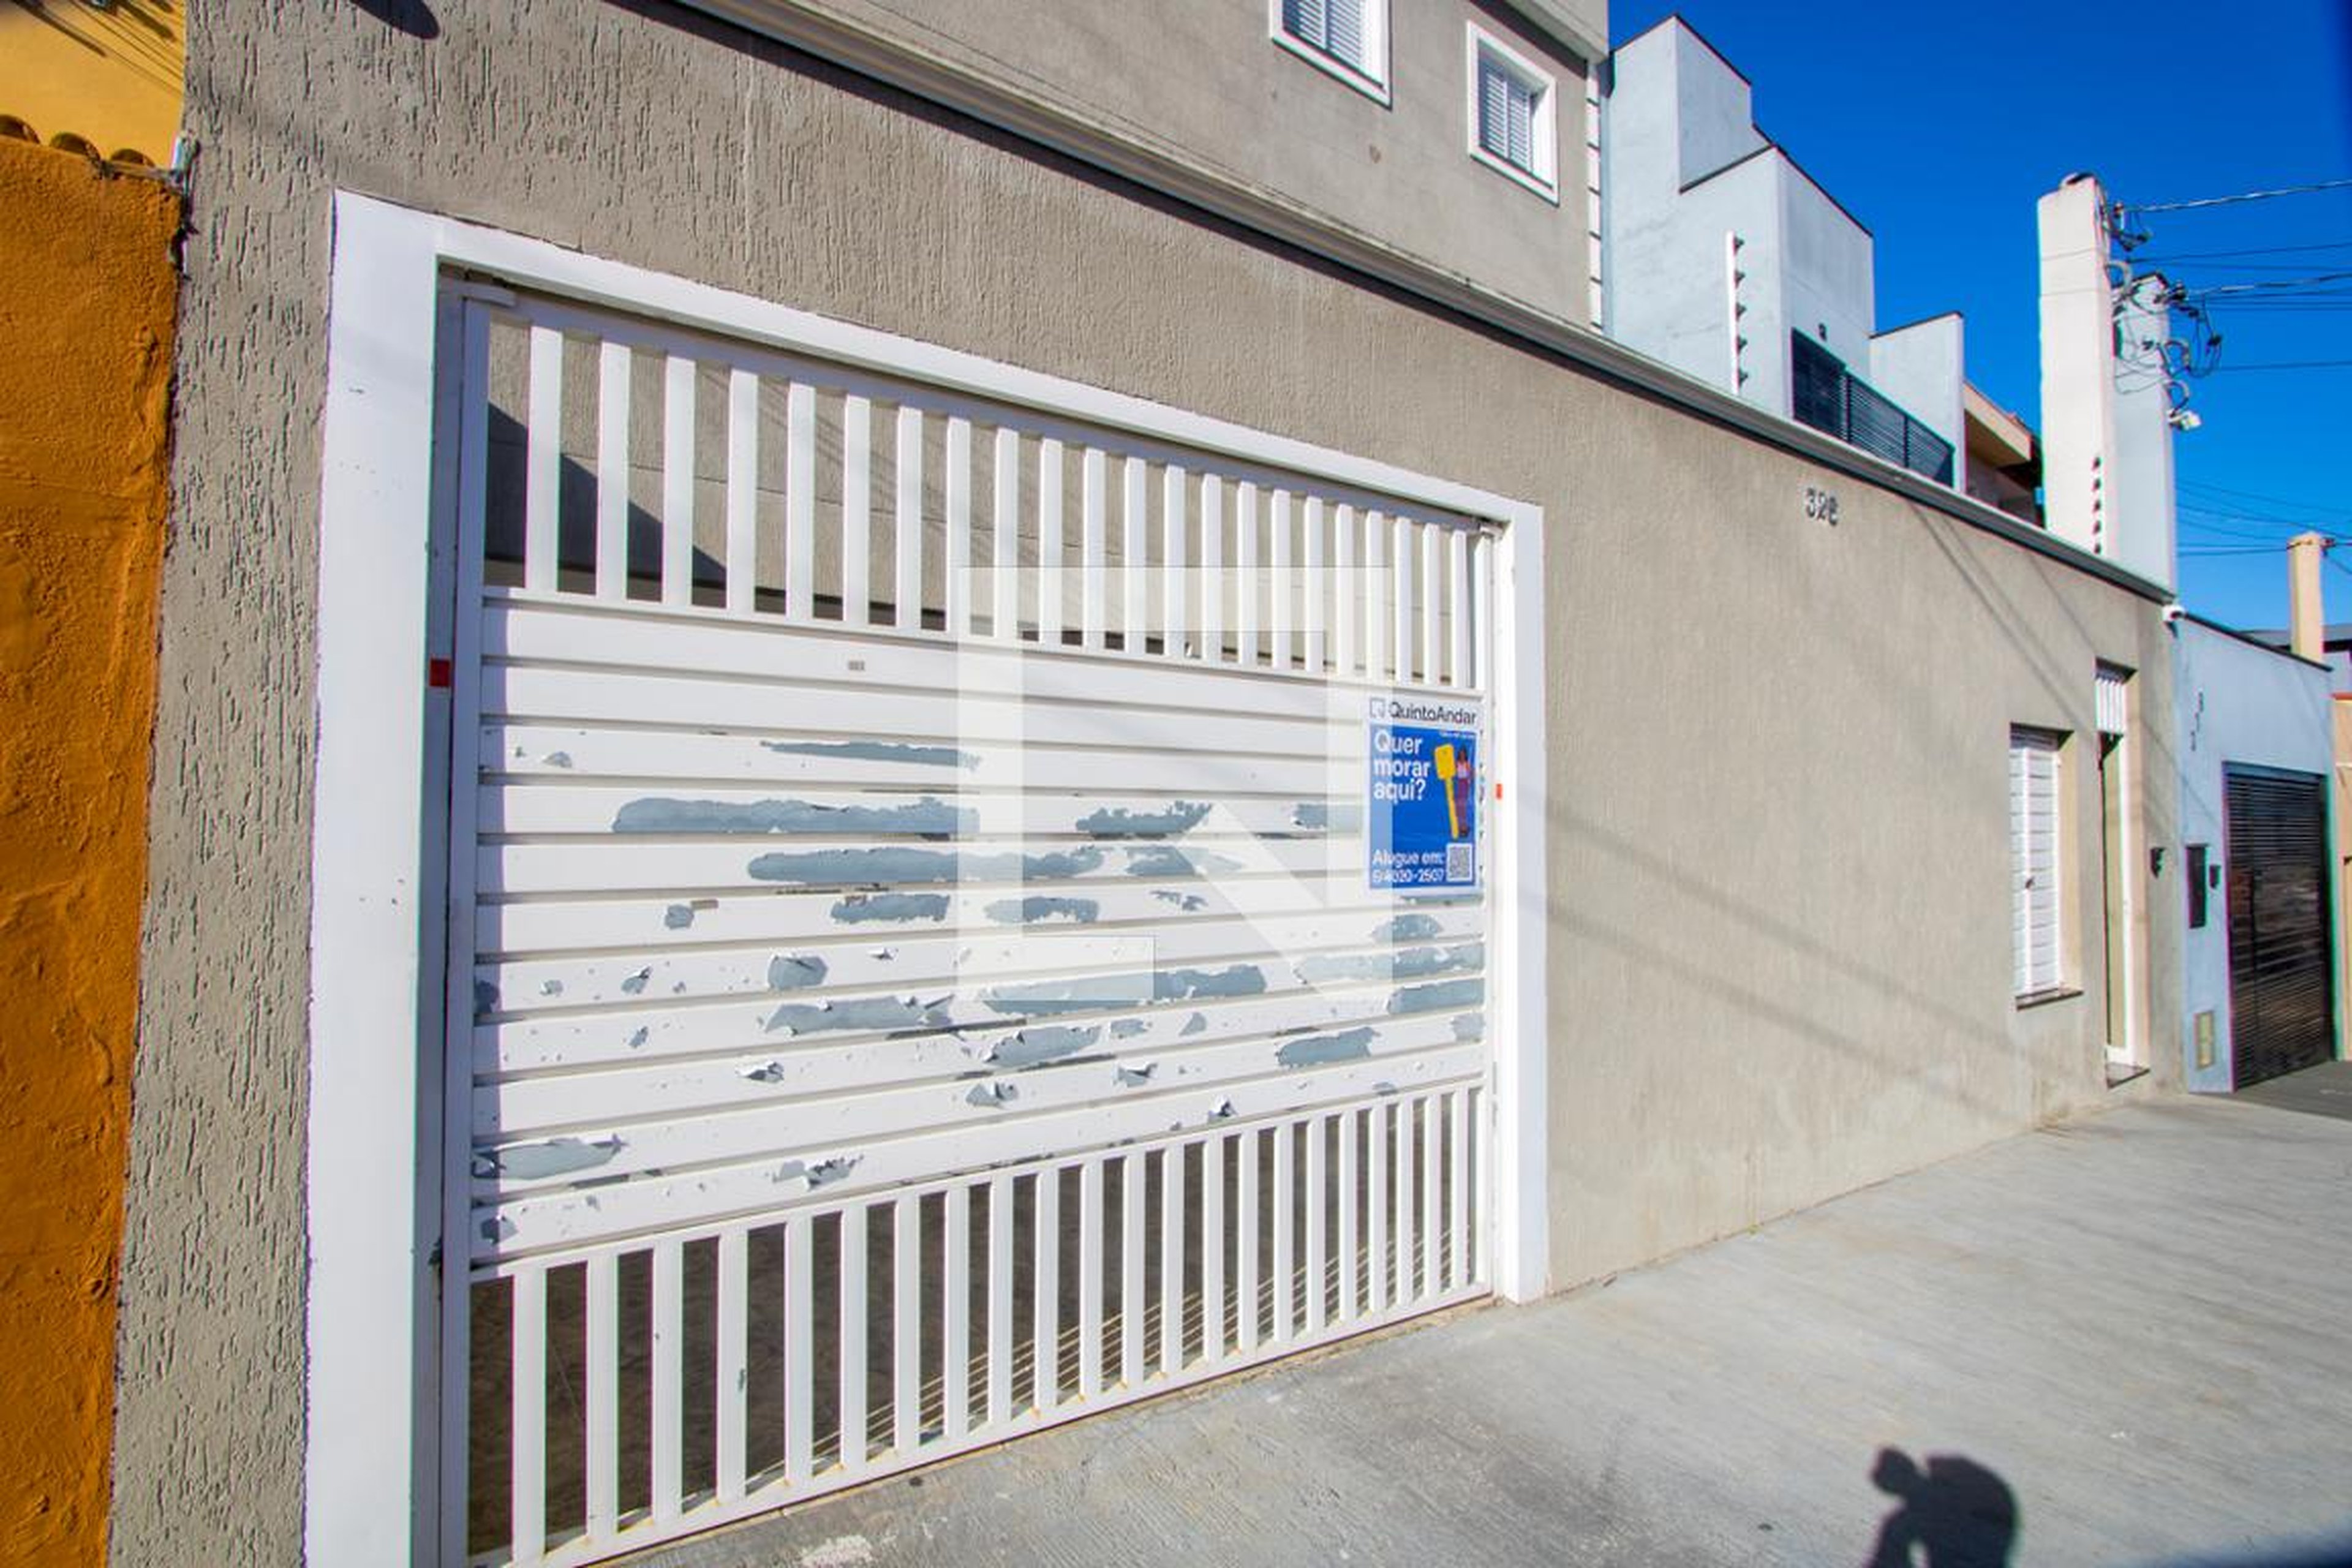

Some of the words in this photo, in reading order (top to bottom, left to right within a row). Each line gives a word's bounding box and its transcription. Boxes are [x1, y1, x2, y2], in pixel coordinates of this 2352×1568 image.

[1389, 701, 1477, 725] QuintoAndar
[1374, 729, 1423, 755] Quer
[1373, 758, 1431, 778] morar
[1373, 778, 1427, 805] aqui?
[1372, 849, 1419, 869] Alugue
